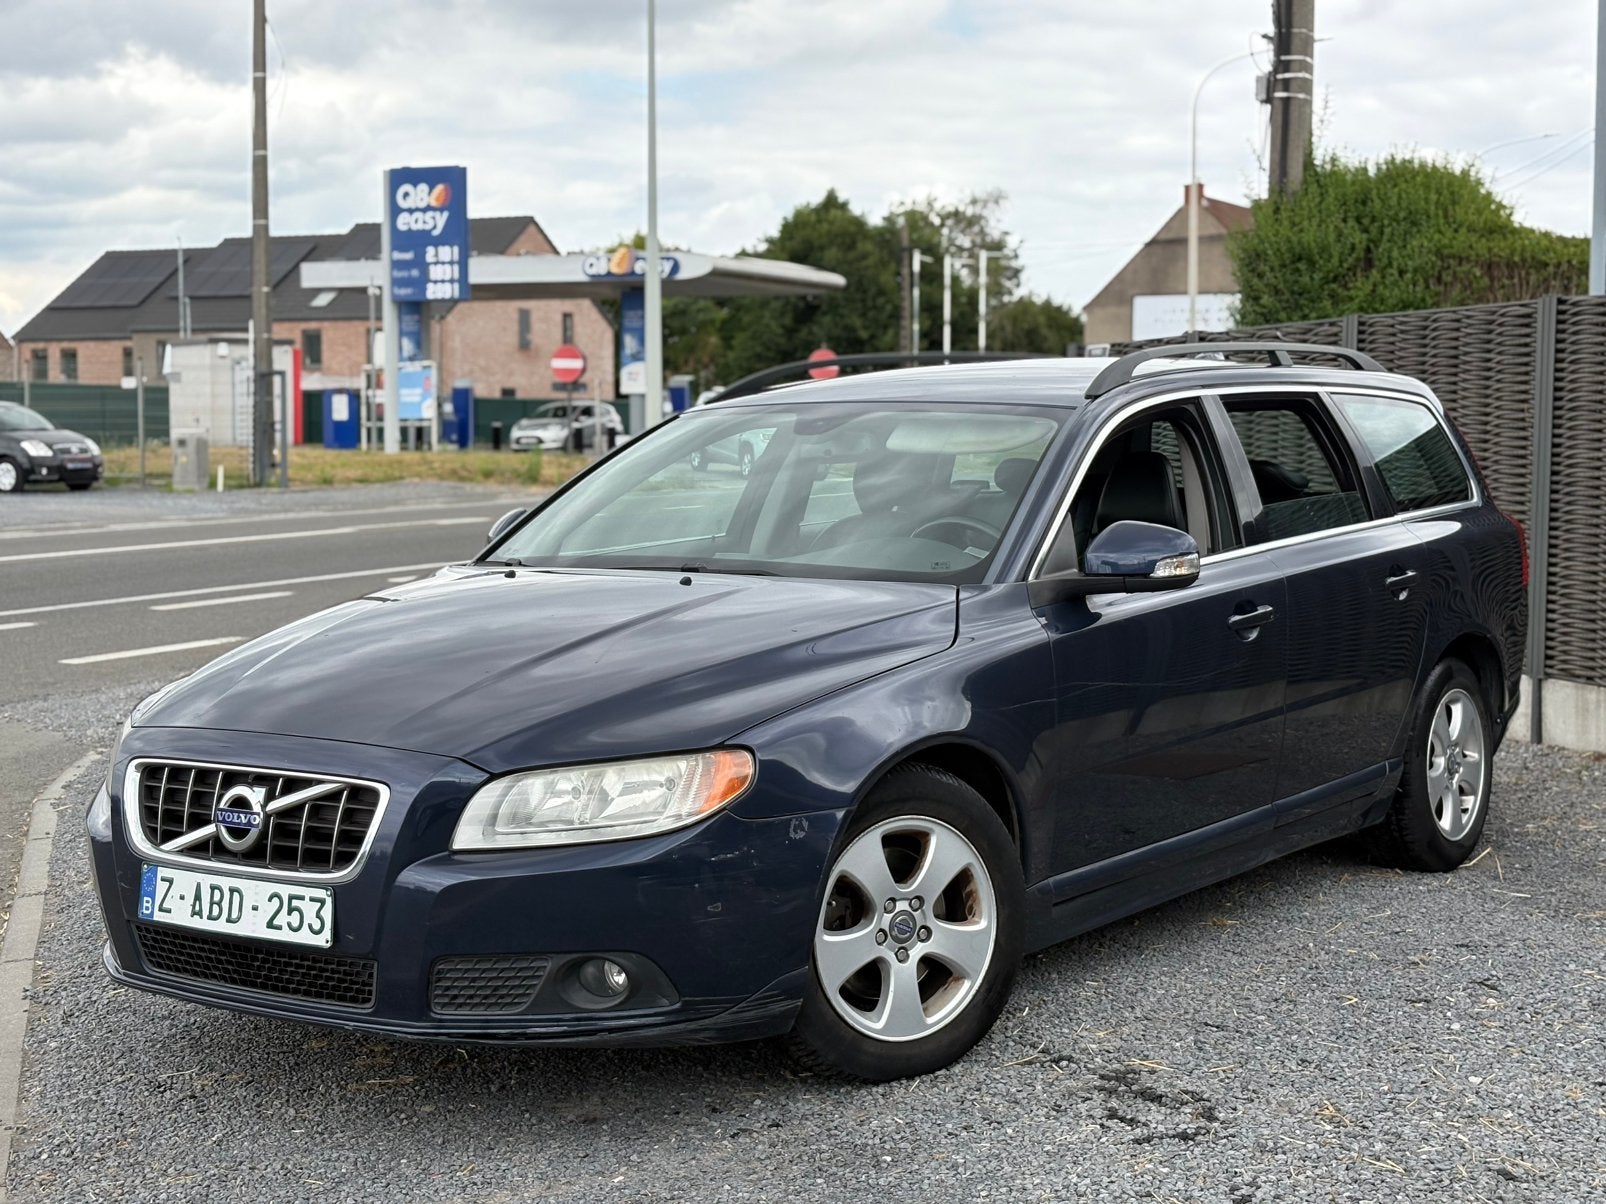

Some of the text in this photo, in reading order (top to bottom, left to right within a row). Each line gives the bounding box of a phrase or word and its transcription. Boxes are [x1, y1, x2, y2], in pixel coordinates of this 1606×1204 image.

[396, 182, 430, 209] Q8
[396, 210, 449, 236] easy
[633, 257, 674, 279] ey
[217, 810, 261, 826] VOLVO
[142, 896, 153, 915] B
[158, 875, 327, 935] Z-ABD-253
